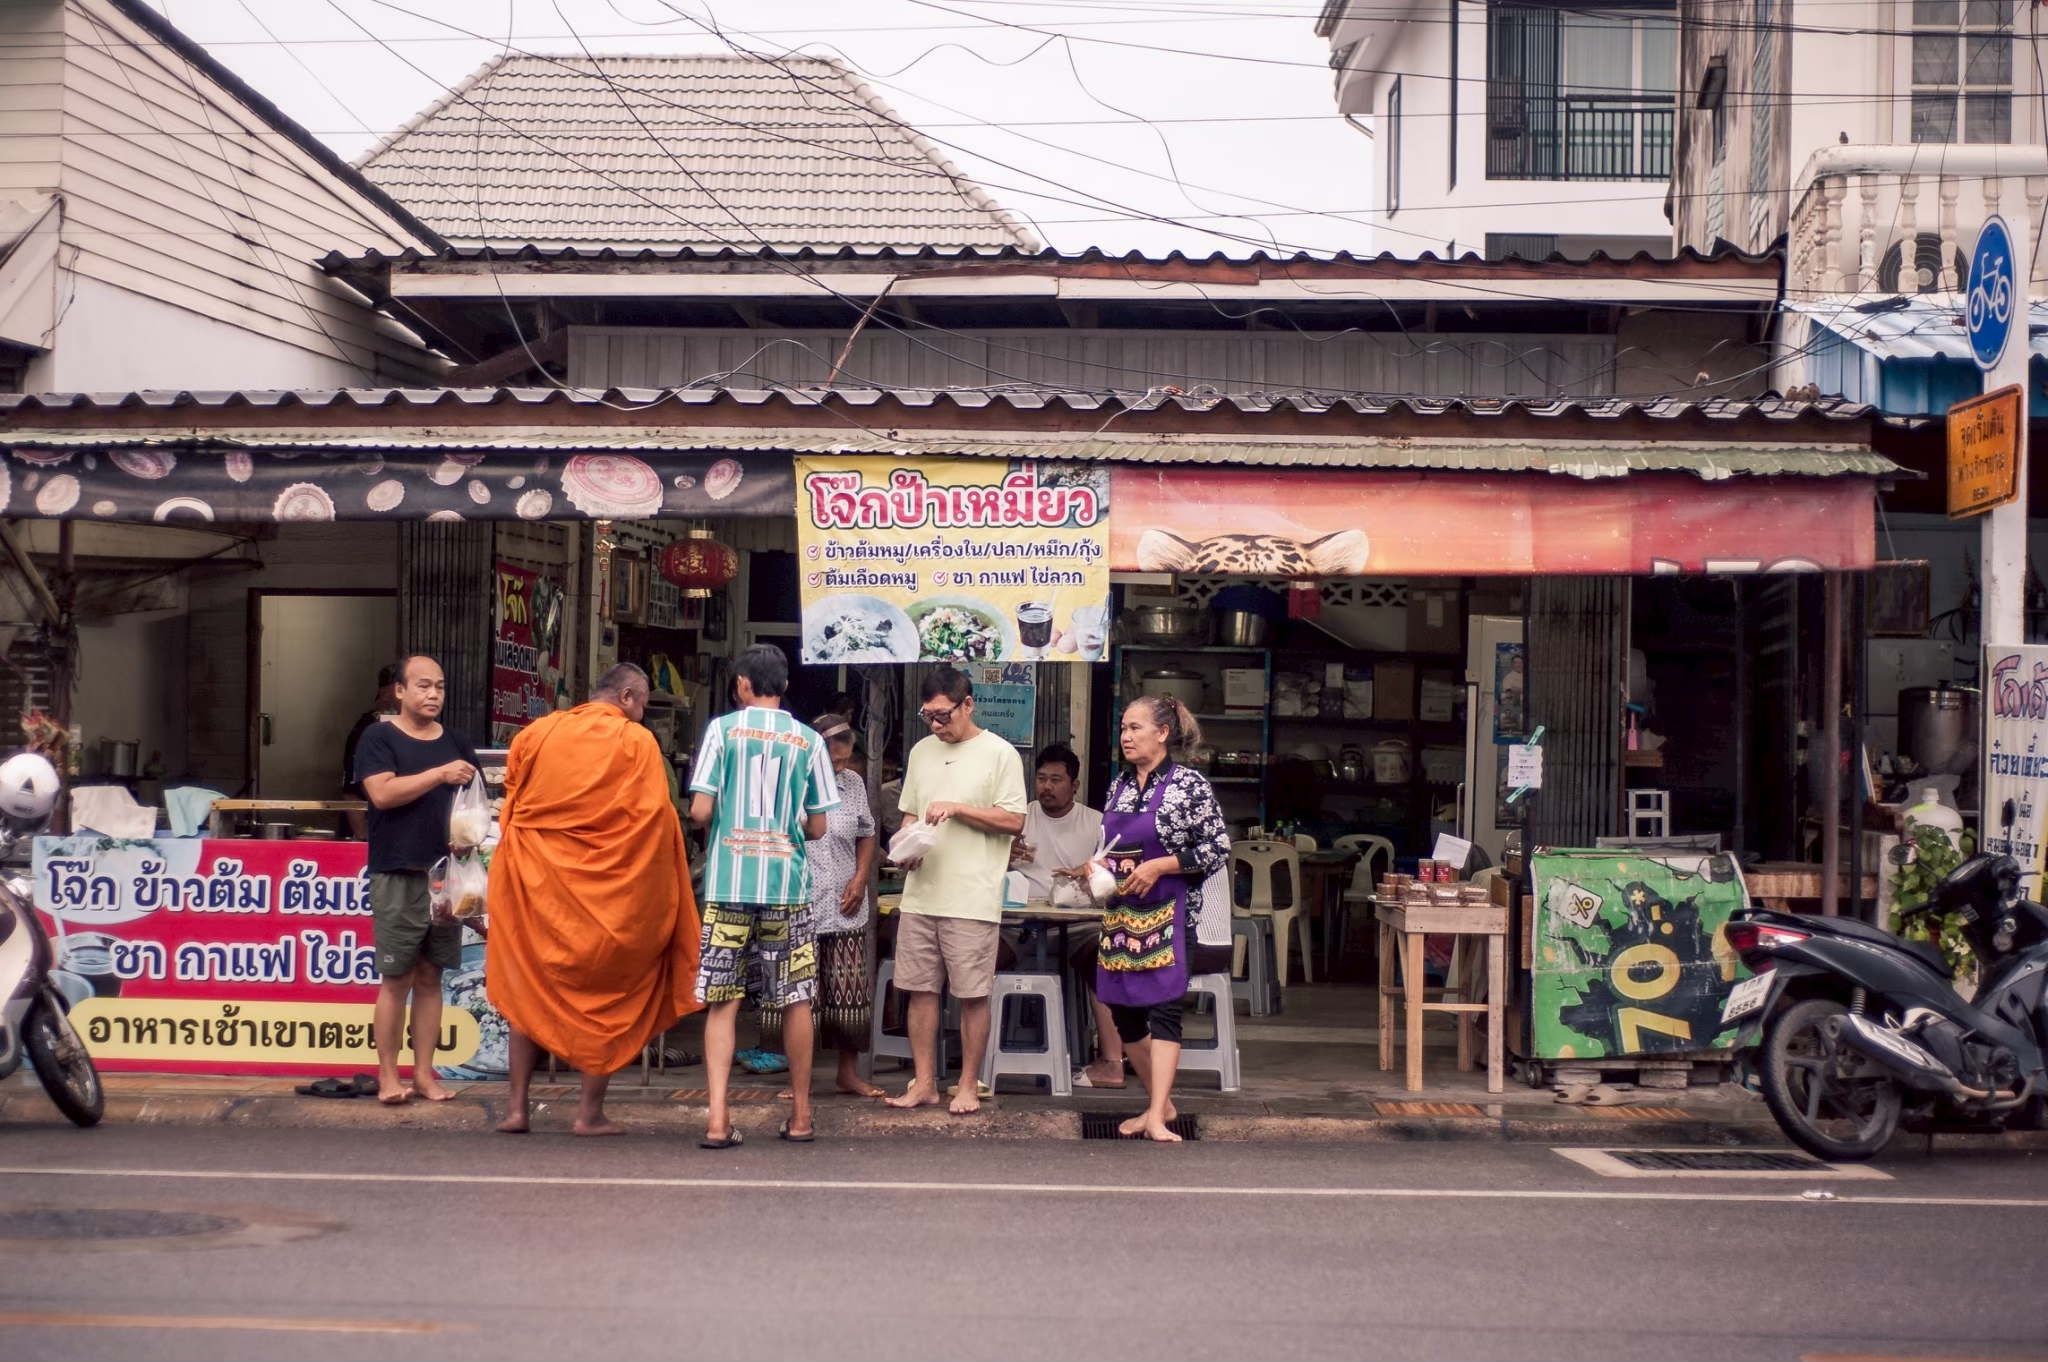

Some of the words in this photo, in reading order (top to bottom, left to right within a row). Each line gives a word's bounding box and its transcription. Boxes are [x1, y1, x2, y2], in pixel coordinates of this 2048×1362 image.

[808, 462, 1095, 526] โจ๊กป้าเหมี่ยว
[501, 571, 527, 626] โจ๊ก
[825, 568, 917, 590] ต้มเลือดหมู
[953, 571, 975, 585] ชา
[979, 568, 1025, 585] กาแฟ
[1030, 566, 1084, 585] ไข่ลวก
[750, 753, 783, 819] 11
[46, 856, 116, 908] โจ๊ก
[133, 857, 265, 911] ข้าวต้ม
[114, 939, 163, 977] ชา
[178, 938, 293, 980] กาแฟ
